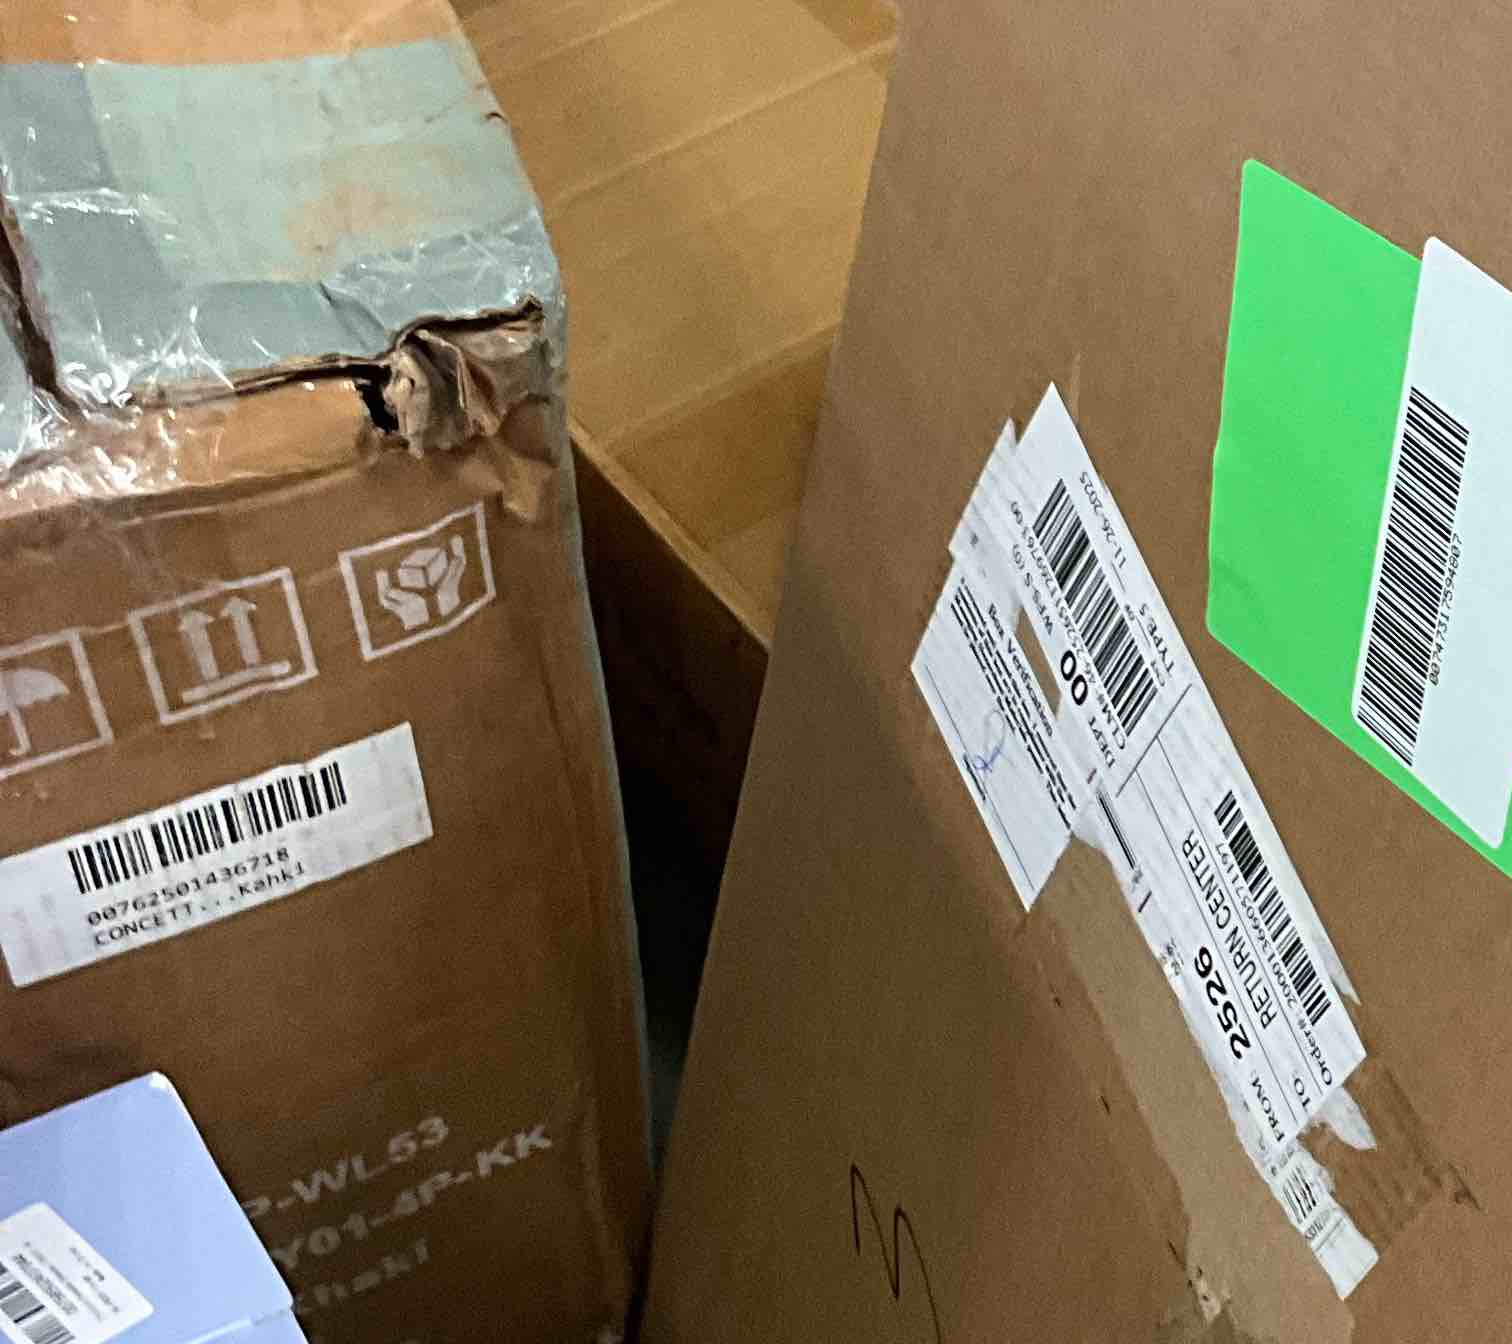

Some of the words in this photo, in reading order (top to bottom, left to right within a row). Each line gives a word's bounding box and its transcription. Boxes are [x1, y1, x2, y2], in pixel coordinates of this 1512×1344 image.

[1056, 646, 1092, 708] 00
[1174, 826, 1236, 931] CENTER
[1186, 942, 1256, 1063] 2526
[1220, 924, 1281, 1031] RETURN
[1246, 1070, 1287, 1144] FROM:
